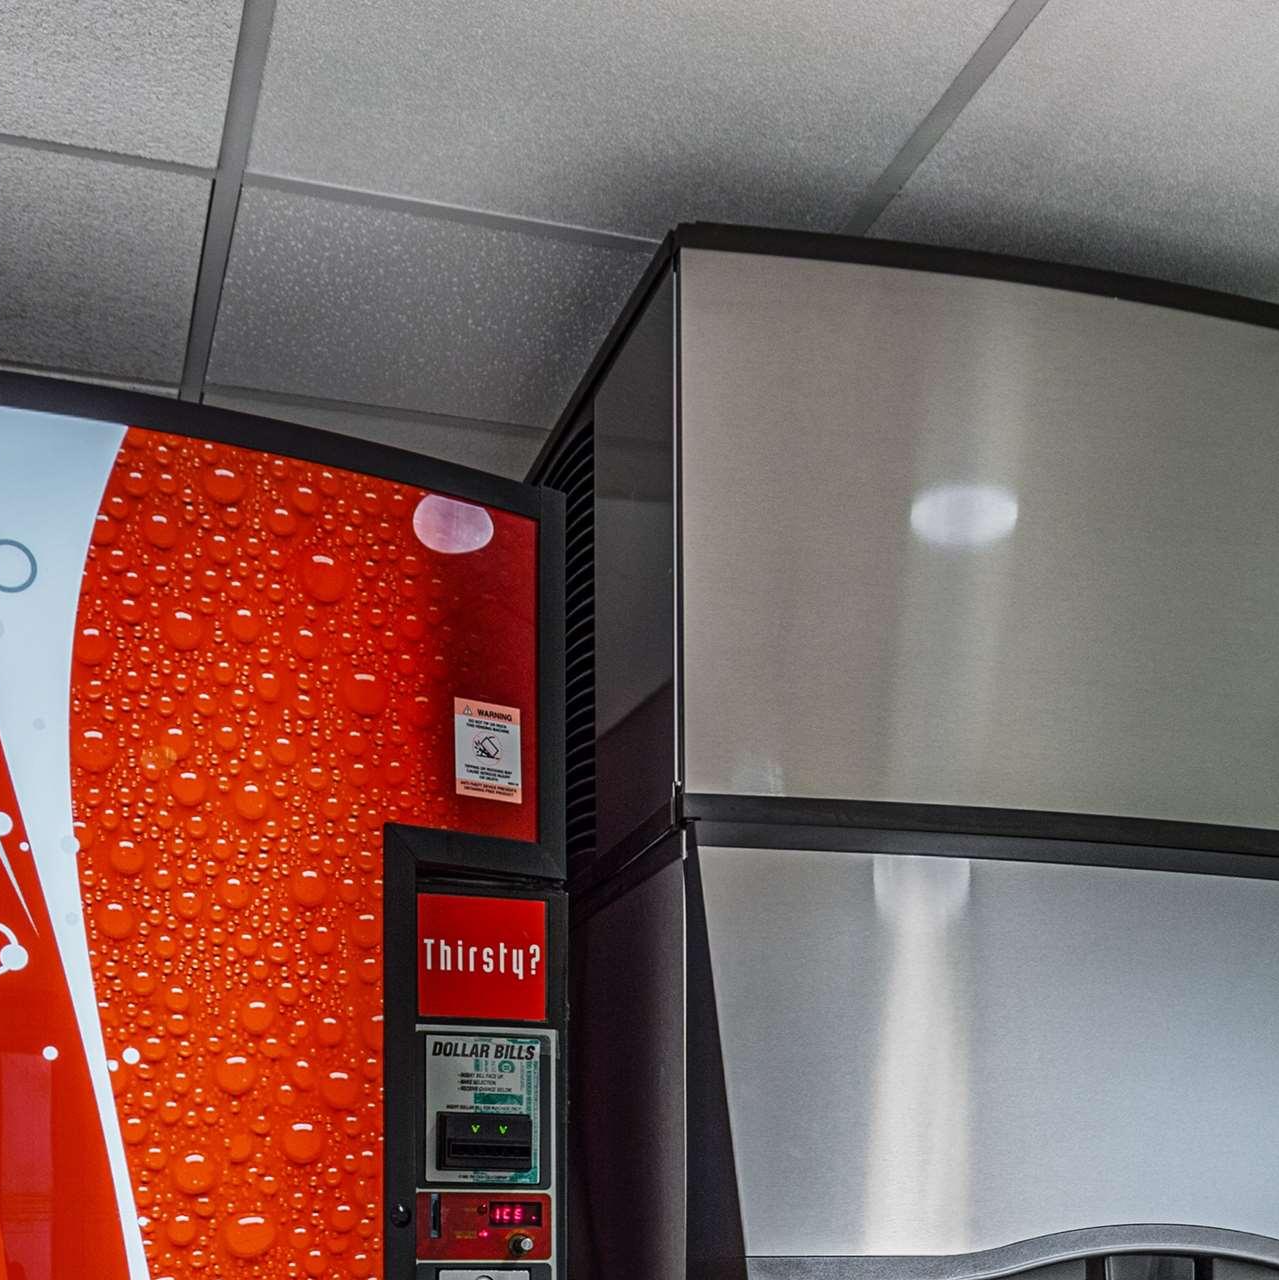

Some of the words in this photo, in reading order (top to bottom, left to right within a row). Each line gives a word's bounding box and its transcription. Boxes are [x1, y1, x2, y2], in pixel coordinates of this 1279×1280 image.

[477, 708, 512, 722] WARNING
[423, 938, 541, 980] Thirsty?
[432, 1041, 490, 1058] DOLLAR
[494, 1043, 536, 1060] BILLS
